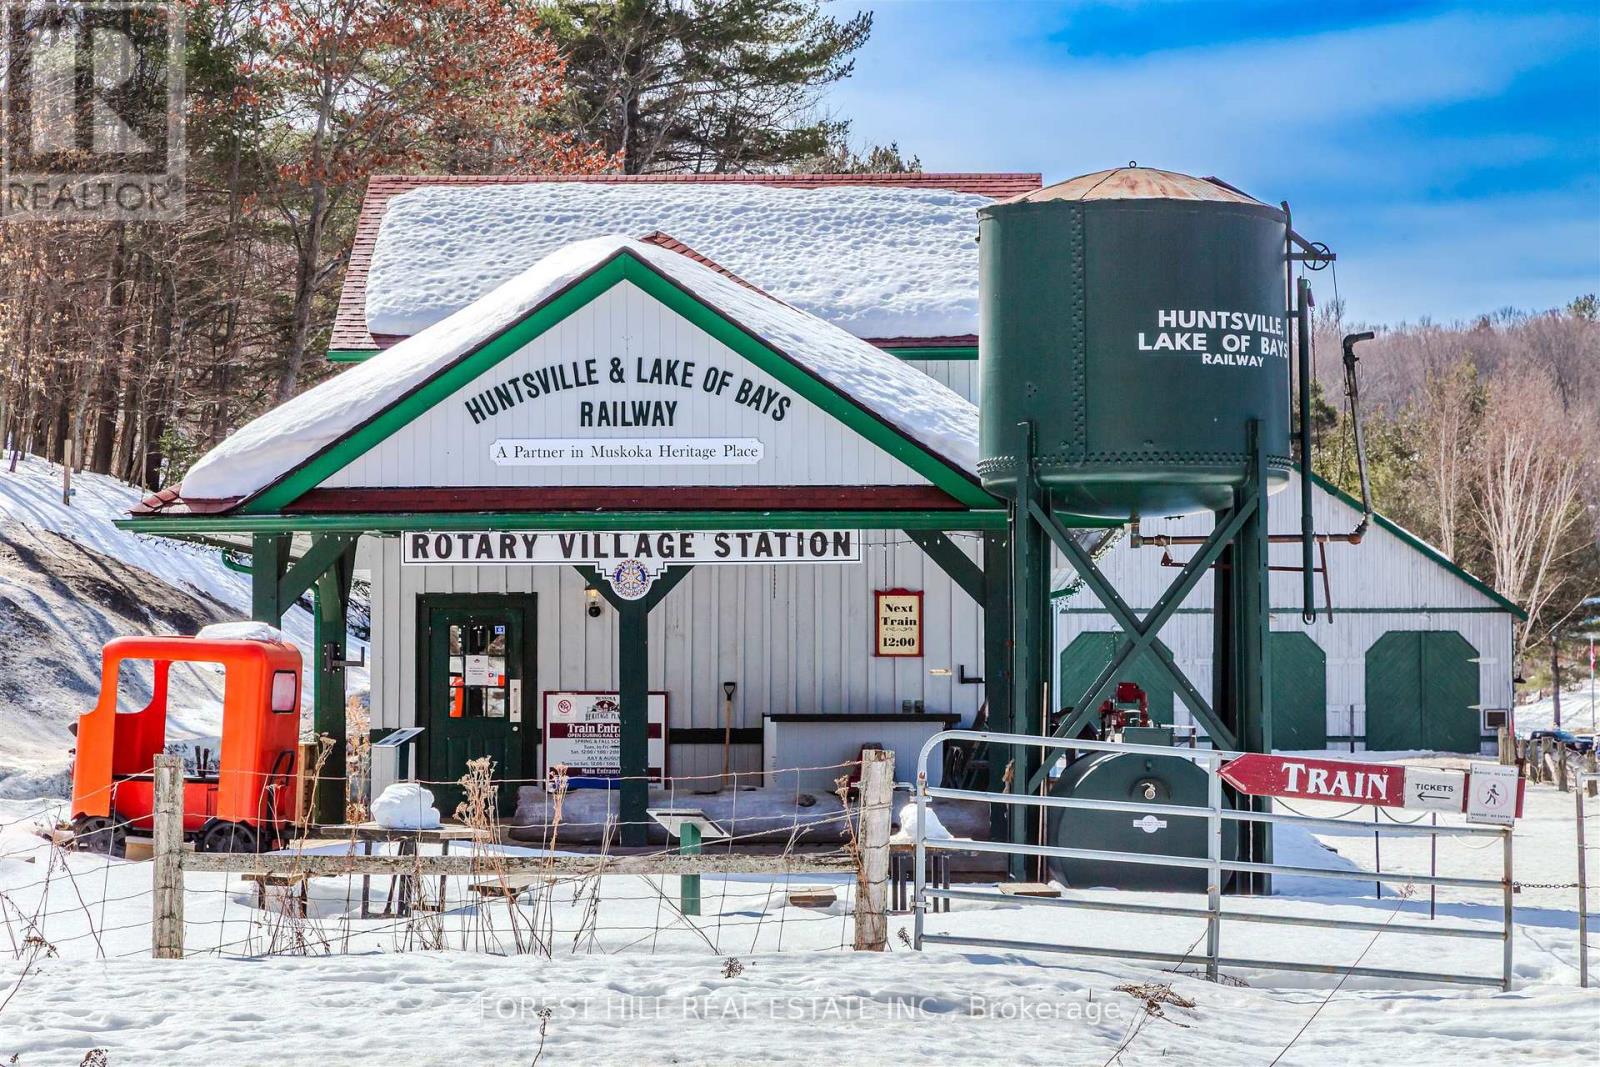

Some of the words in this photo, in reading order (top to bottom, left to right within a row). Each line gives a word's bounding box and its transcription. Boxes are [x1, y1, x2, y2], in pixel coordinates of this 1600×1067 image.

[1138, 332, 1207, 351] LAKE
[1222, 334, 1250, 352] OF
[1261, 336, 1288, 359] BAYS
[1202, 353, 1264, 367] RAILWAY
[464, 358, 599, 425] HUNTSVILLE
[609, 357, 625, 384] &
[636, 357, 695, 388] LAKE
[702, 366, 733, 396] OF
[735, 378, 792, 422] BAYS
[580, 400, 678, 427] RAILWAY
[496, 446, 507, 459] A
[514, 446, 565, 459] Partner
[571, 445, 583, 458] in
[591, 445, 652, 458] Muskoka
[659, 444, 716, 460] Heritage
[724, 444, 758, 458] Place
[411, 533, 537, 559] ROTARY
[560, 532, 695, 559] VILLAGE
[714, 531, 851, 558] STATION
[885, 603, 913, 612] Next
[881, 616, 917, 626] Train
[883, 637, 915, 647] 12:00
[567, 723, 595, 733] Train
[1281, 762, 1390, 800] TRAIN
[1415, 782, 1454, 793] TICKETS
